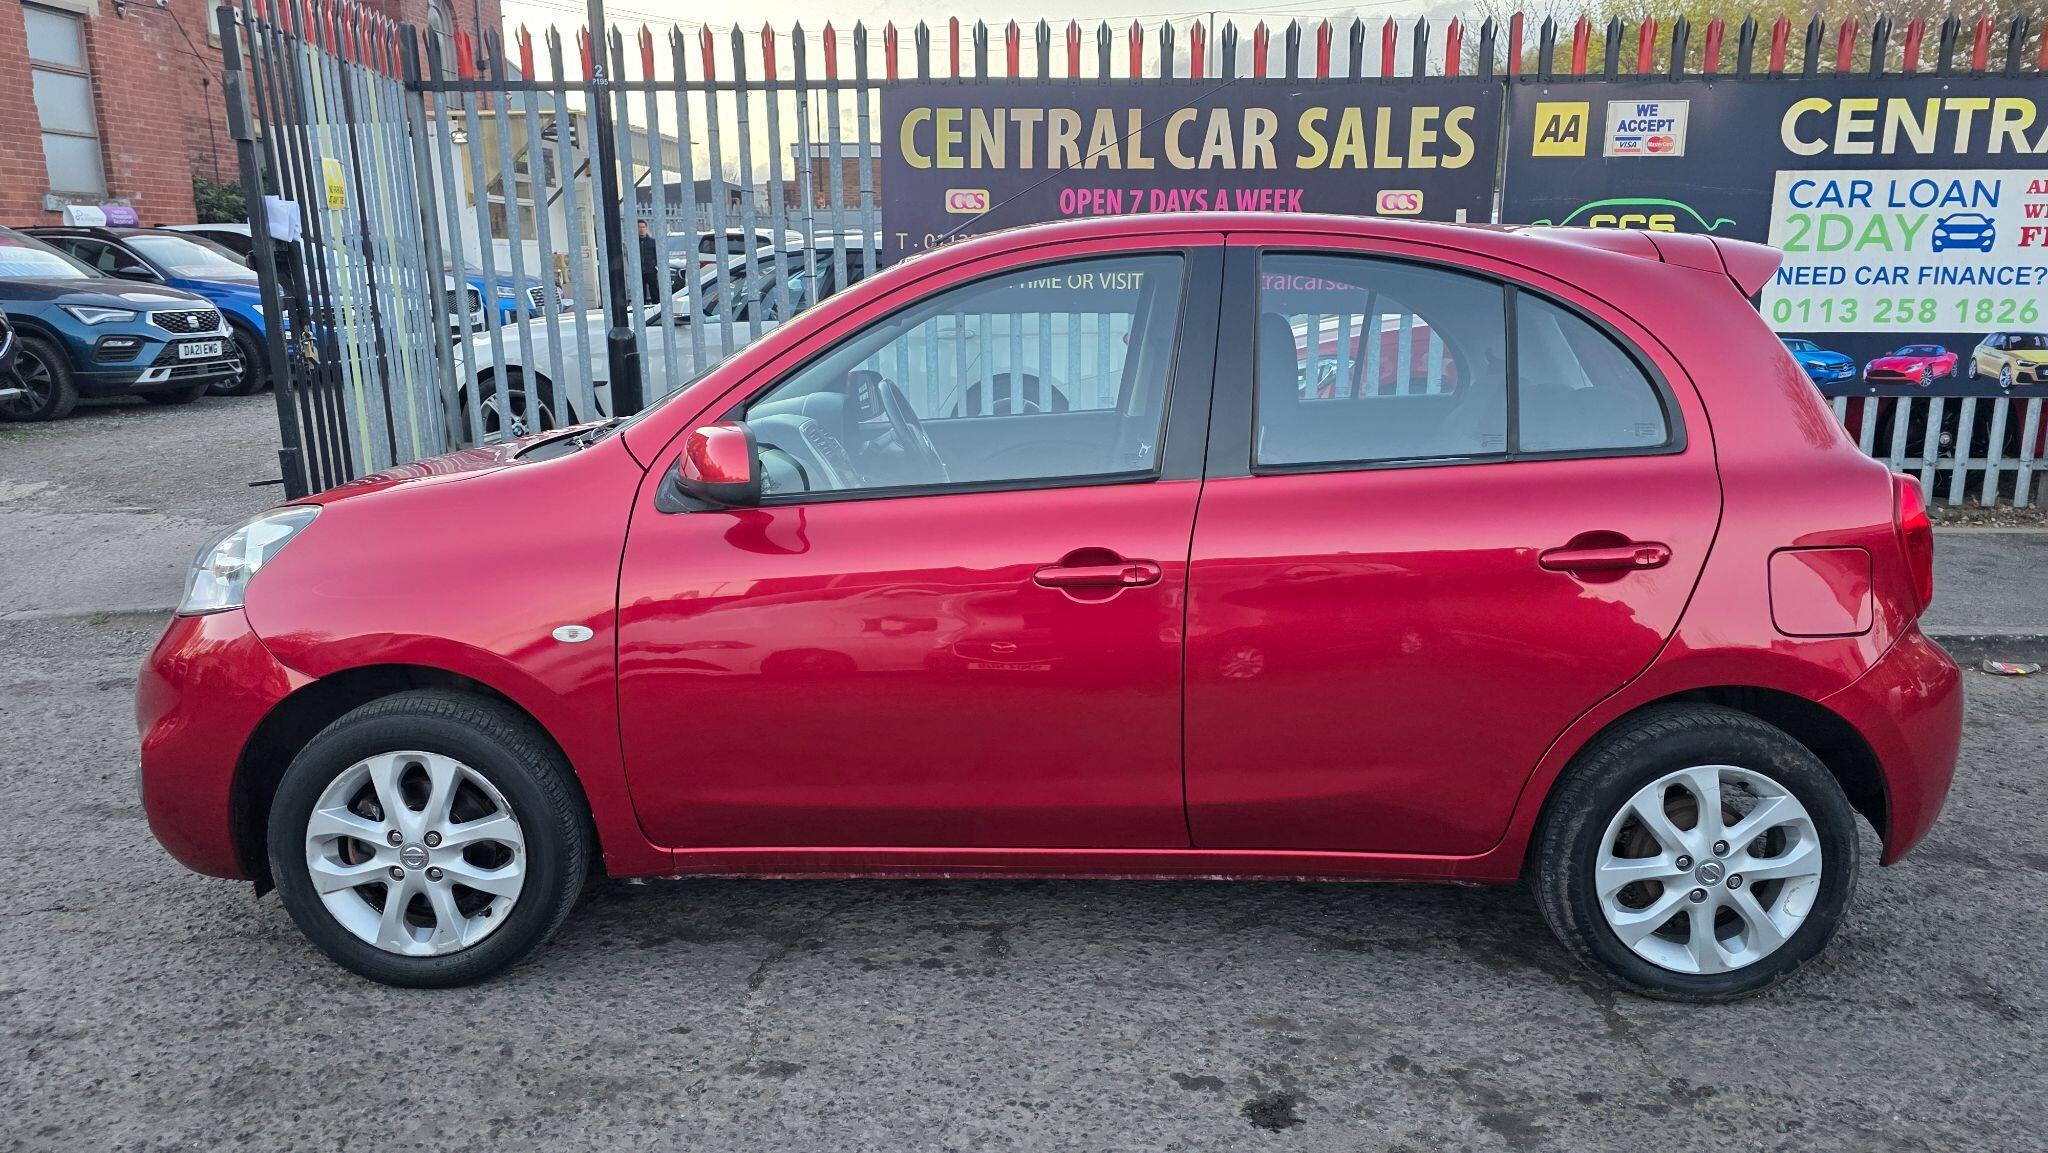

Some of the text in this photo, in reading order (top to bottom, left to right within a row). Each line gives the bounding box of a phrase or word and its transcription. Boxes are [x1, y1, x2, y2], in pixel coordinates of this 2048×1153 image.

[594, 64, 604, 77] 2
[1636, 103, 1659, 117] WE
[1539, 114, 1581, 143] AA
[1616, 119, 1675, 133] ACCEPT
[900, 105, 1476, 170] CENTRAL CAR SALES
[1618, 141, 1638, 149] VISA
[1647, 140, 1674, 148] MasterCard
[1059, 188, 1305, 215] OPEN 7 DAYS A WEEK
[1788, 179, 2002, 209] CAR LOAN
[1782, 213, 1930, 252] 2DAY
[1067, 273, 1094, 290] OR
[1099, 272, 1144, 290] VISIT
[1776, 265, 2048, 286] NEED CAR FINANCE?
[1772, 298, 2040, 324] 0113 258 1826
[184, 343, 218, 356] DA21 EWG
